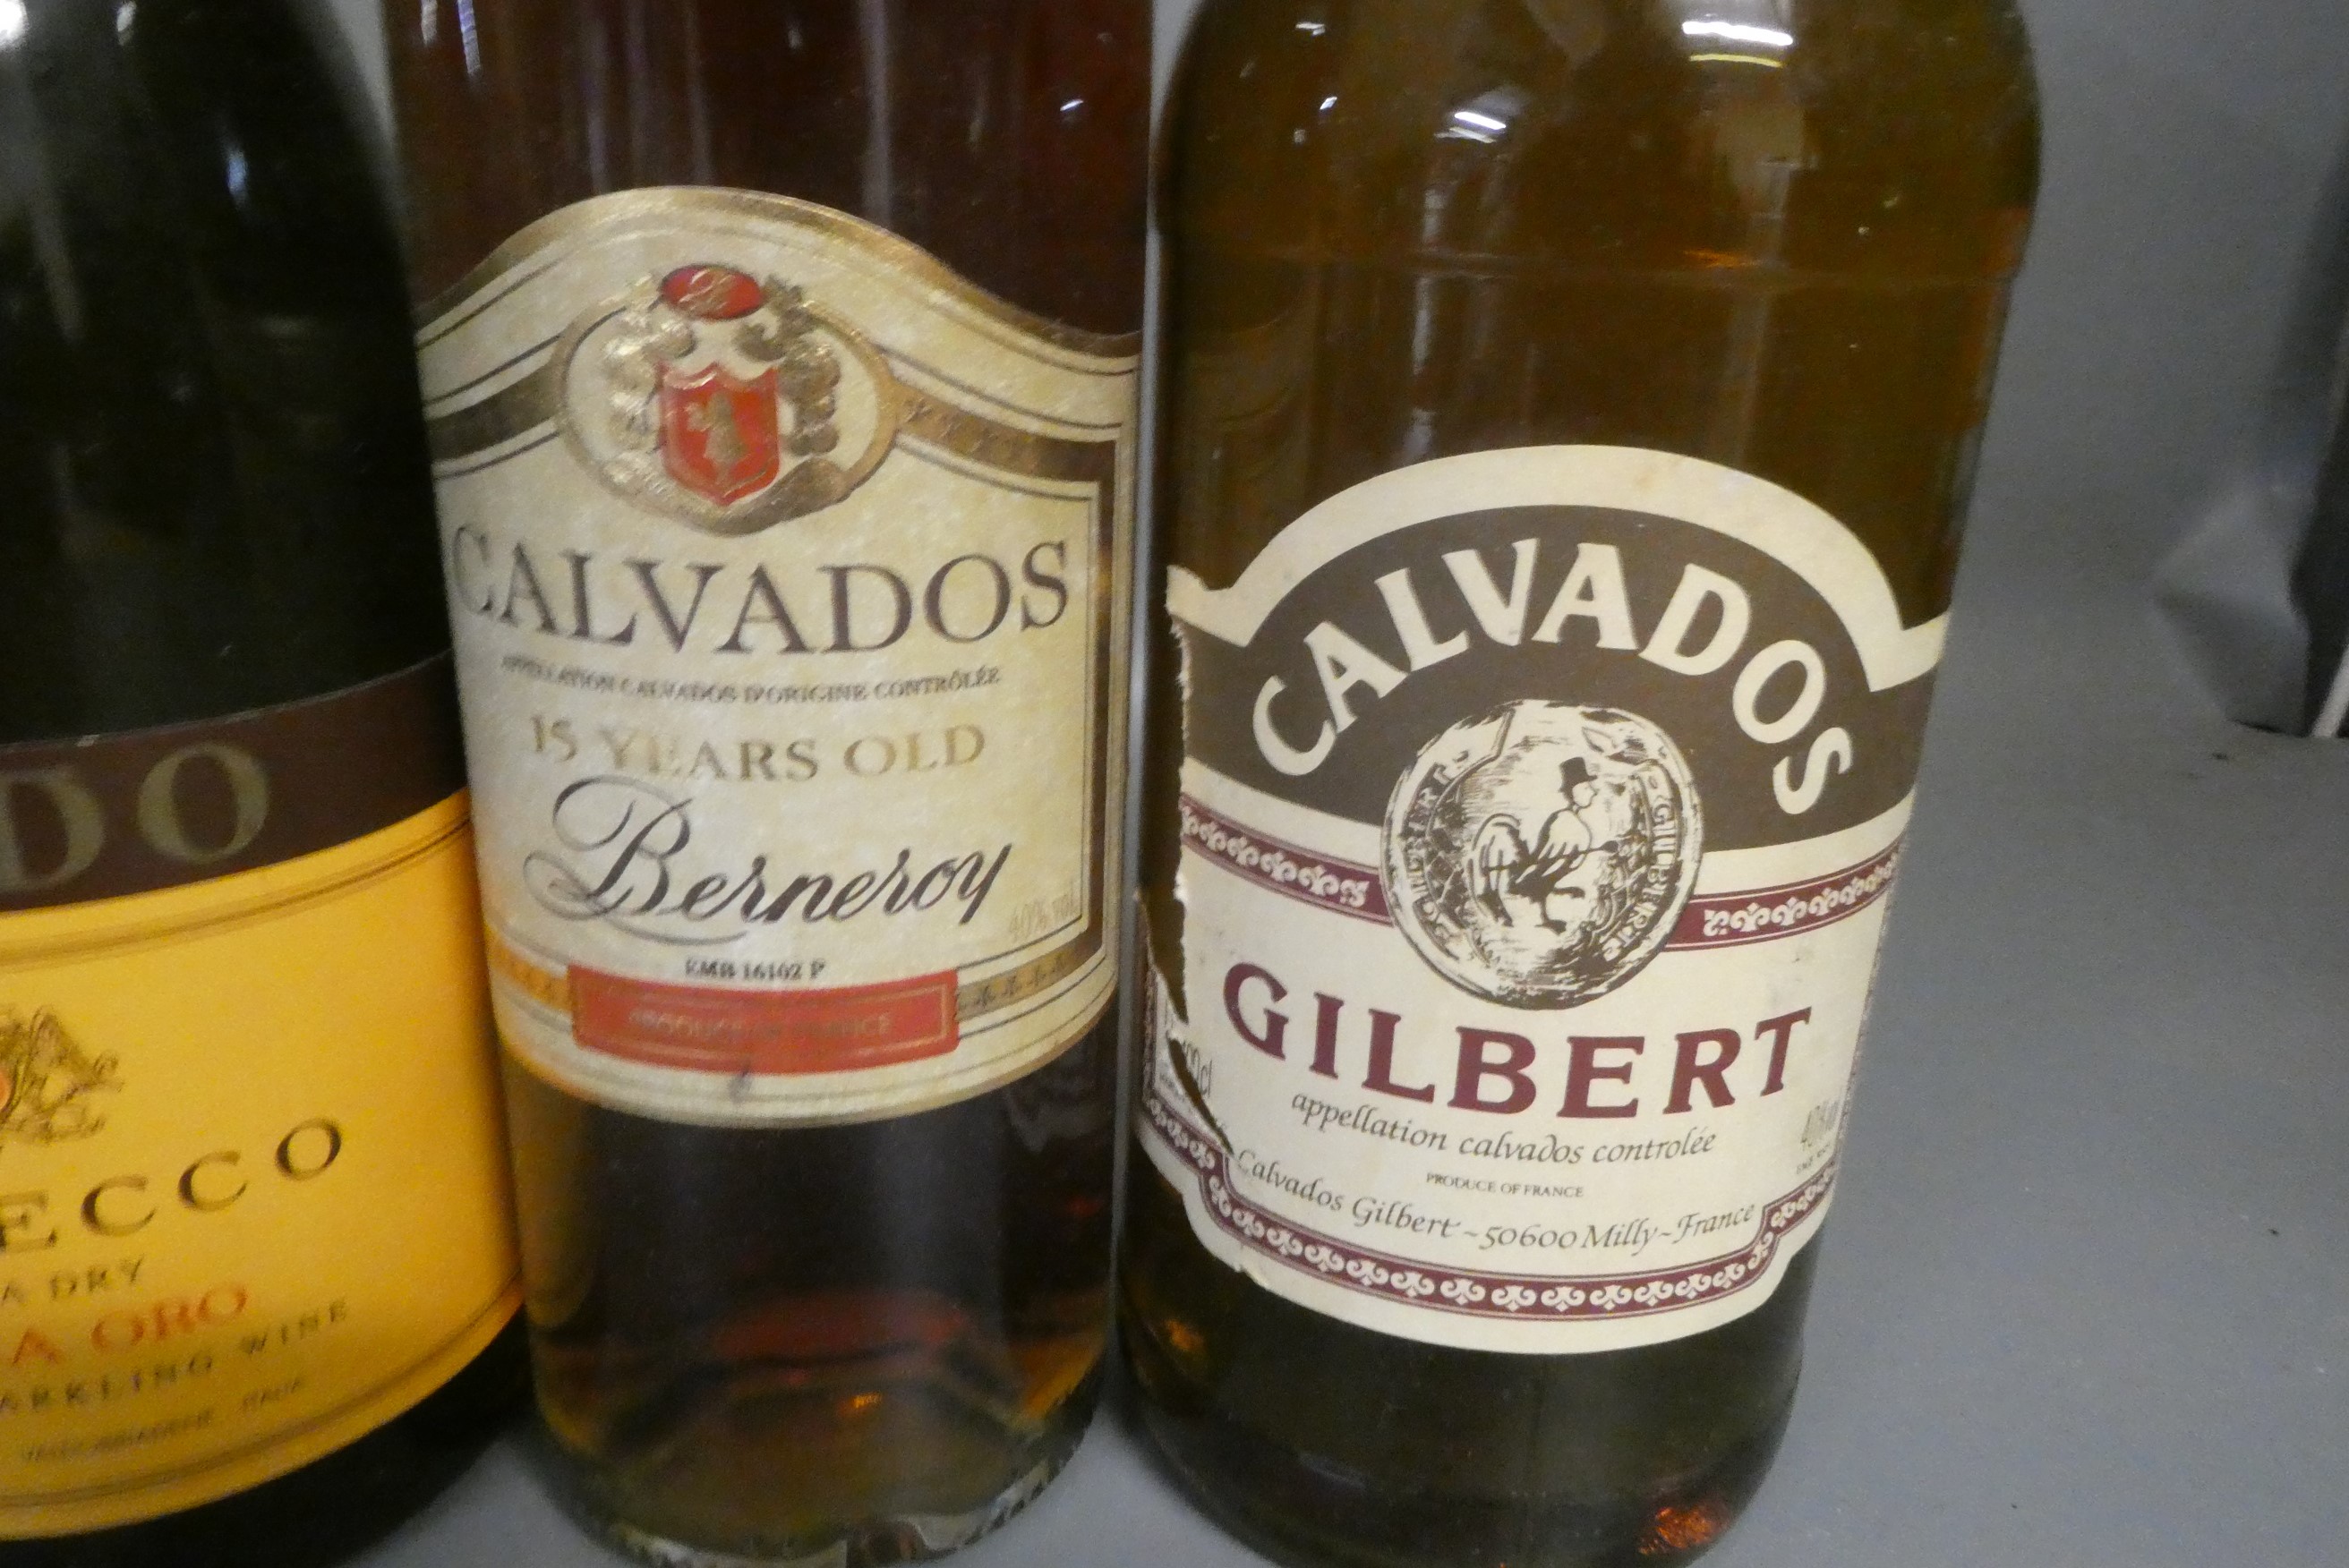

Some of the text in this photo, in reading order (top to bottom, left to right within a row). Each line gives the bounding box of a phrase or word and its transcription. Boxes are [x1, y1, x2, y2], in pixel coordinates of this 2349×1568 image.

[450, 523, 1069, 655] CALVADOS
[1252, 538, 1854, 814] CALVADOS
[532, 713, 986, 782] 15 YEARS OLD
[523, 774, 1012, 946] Berneroy
[1223, 962, 1813, 1119] GILBERT
[1292, 1091, 1717, 1164] appellation calvados controlée
[0, 1117, 343, 1253] ECCO
[1237, 1148, 1345, 1212] Calvados
[1426, 1172, 1585, 1197] PRODUCE OF FRANCE
[49, 1254, 143, 1300] DRY
[91, 1282, 248, 1350] ORO
[240, 1298, 347, 1355] WINE
